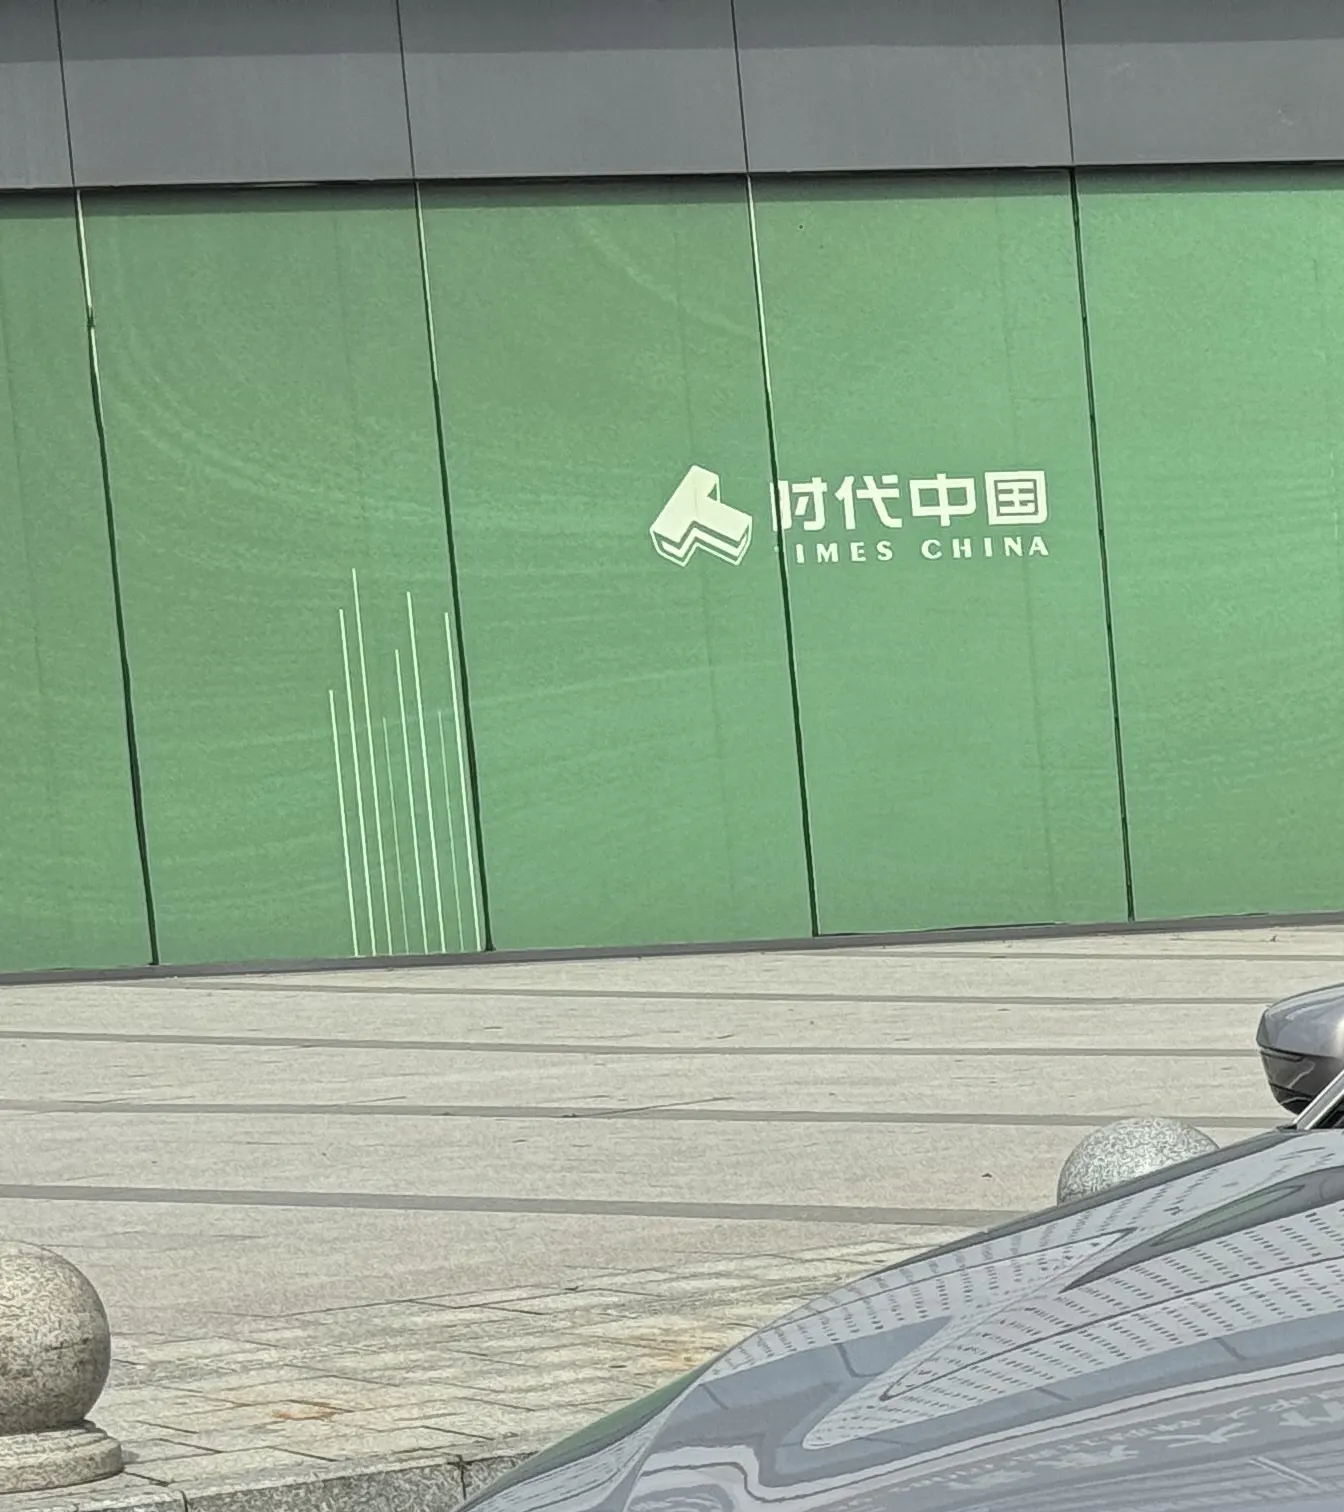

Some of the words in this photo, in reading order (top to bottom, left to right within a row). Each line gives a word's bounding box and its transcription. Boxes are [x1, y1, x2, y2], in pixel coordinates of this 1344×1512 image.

[769, 470, 1048, 531] 时代中国
[773, 540, 894, 564] IMES
[921, 537, 1048, 560] CHINA
